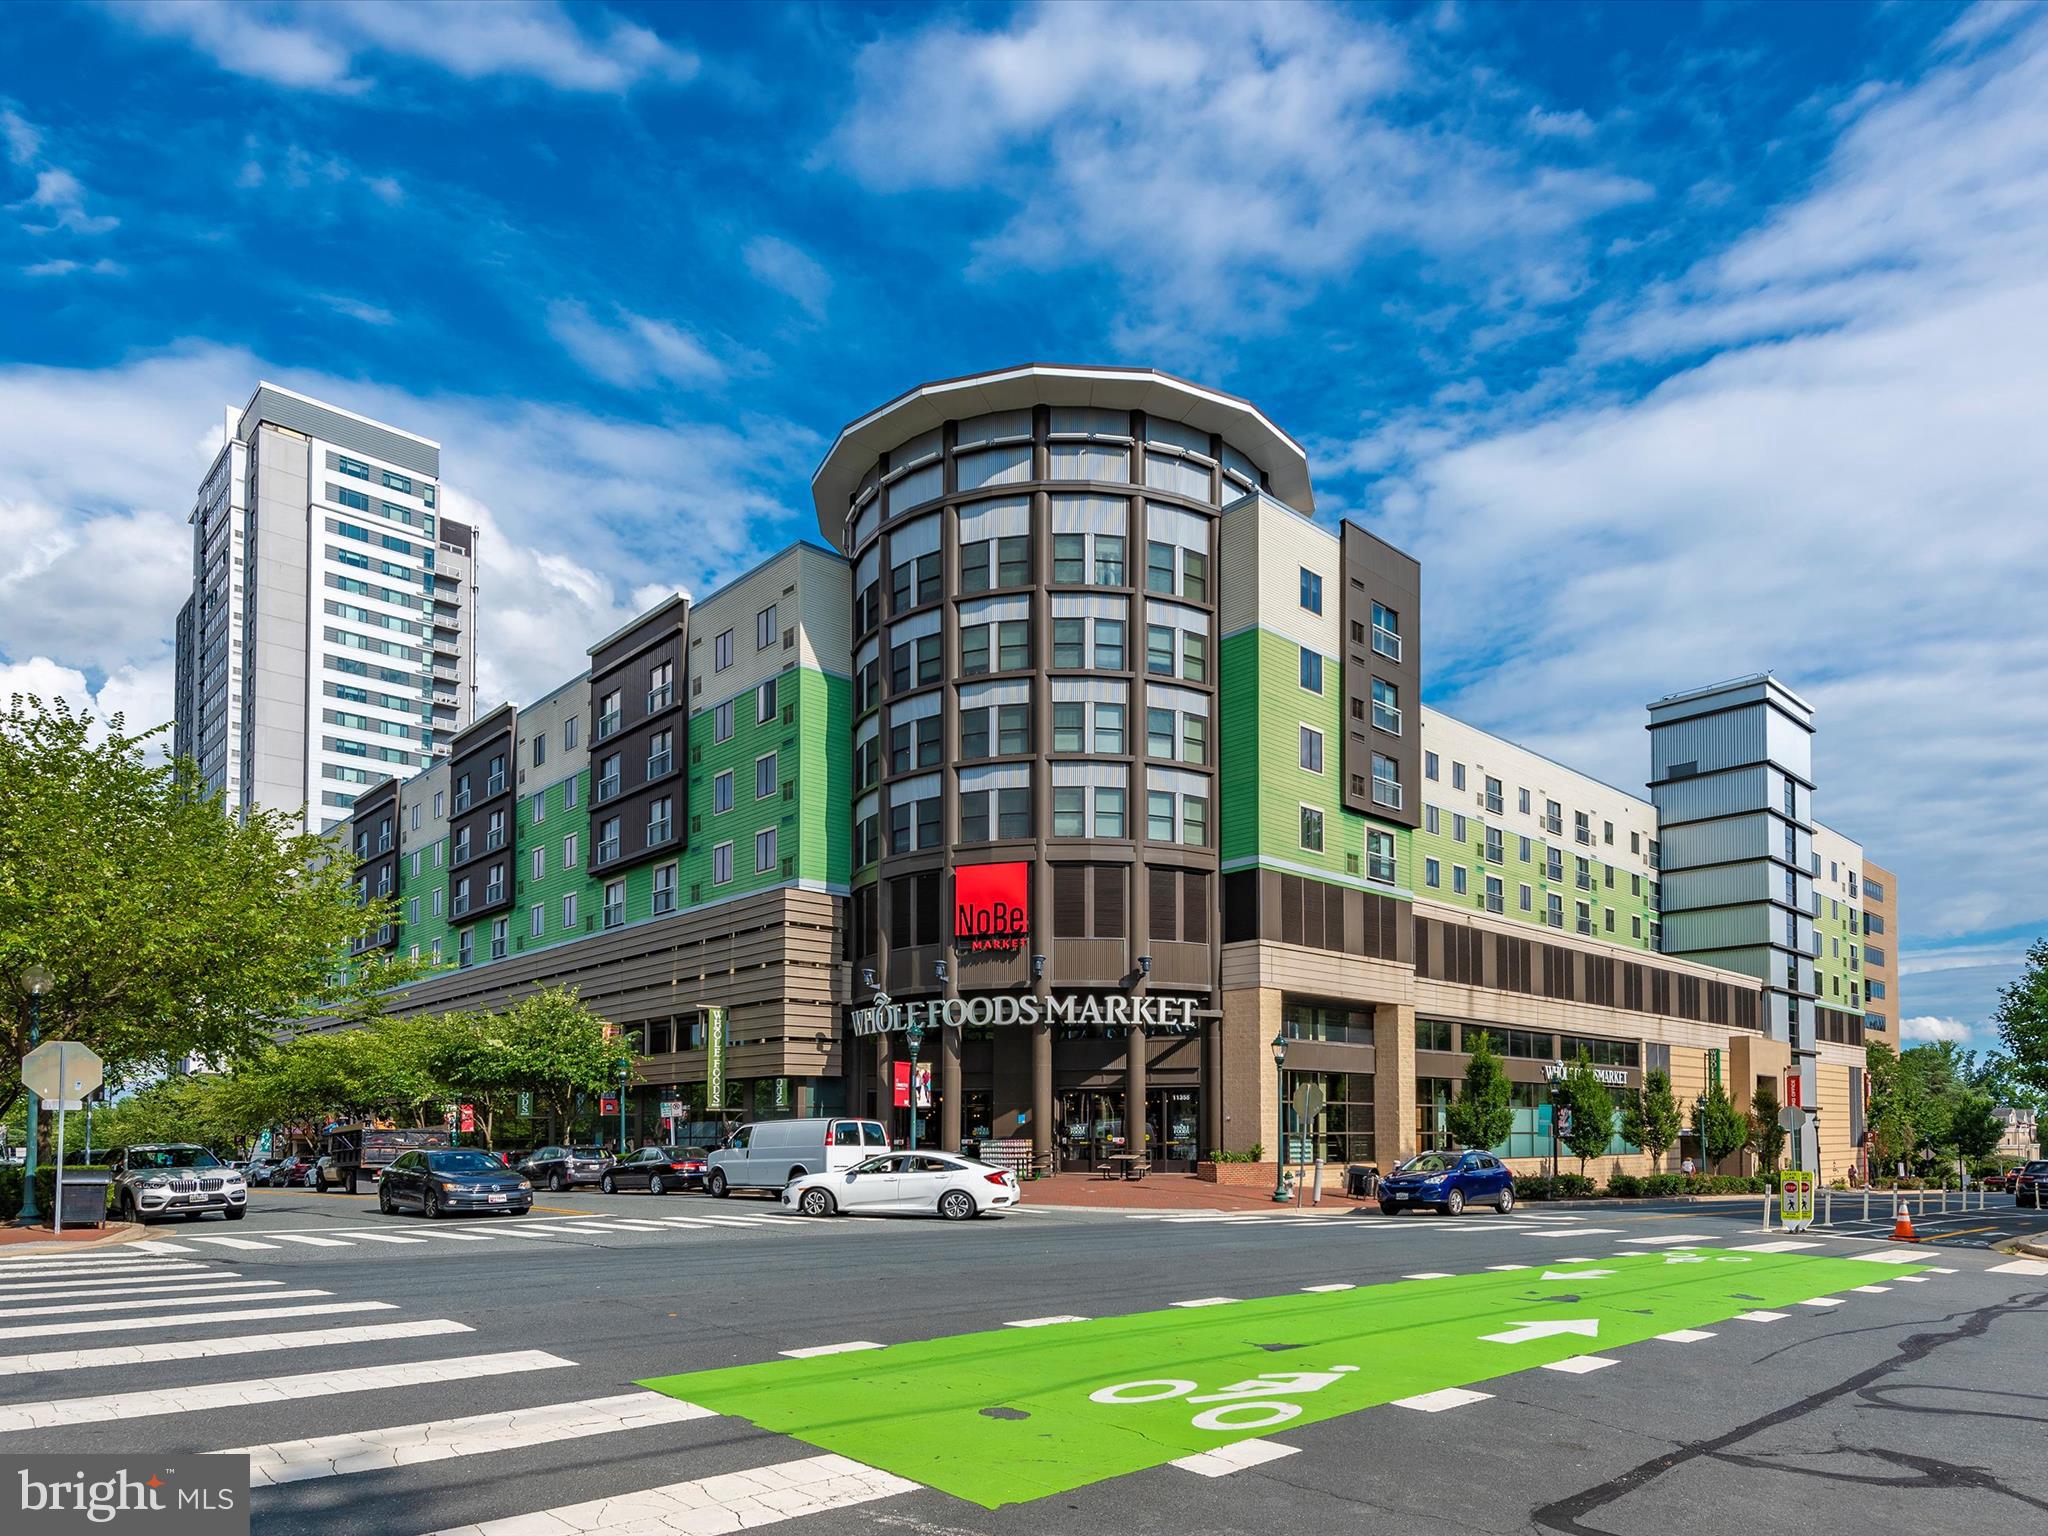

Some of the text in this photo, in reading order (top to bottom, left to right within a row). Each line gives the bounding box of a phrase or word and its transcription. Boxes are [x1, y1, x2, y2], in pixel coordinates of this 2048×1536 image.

[958, 902, 1024, 934] NoBe
[972, 938, 1027, 951] MARKET
[851, 992, 1199, 1037] WHOLE FOODS MARKET
[713, 1010, 722, 1057] WHOLE
[713, 1060, 721, 1103] FOODS
[1600, 1069, 1628, 1084] MARKET
